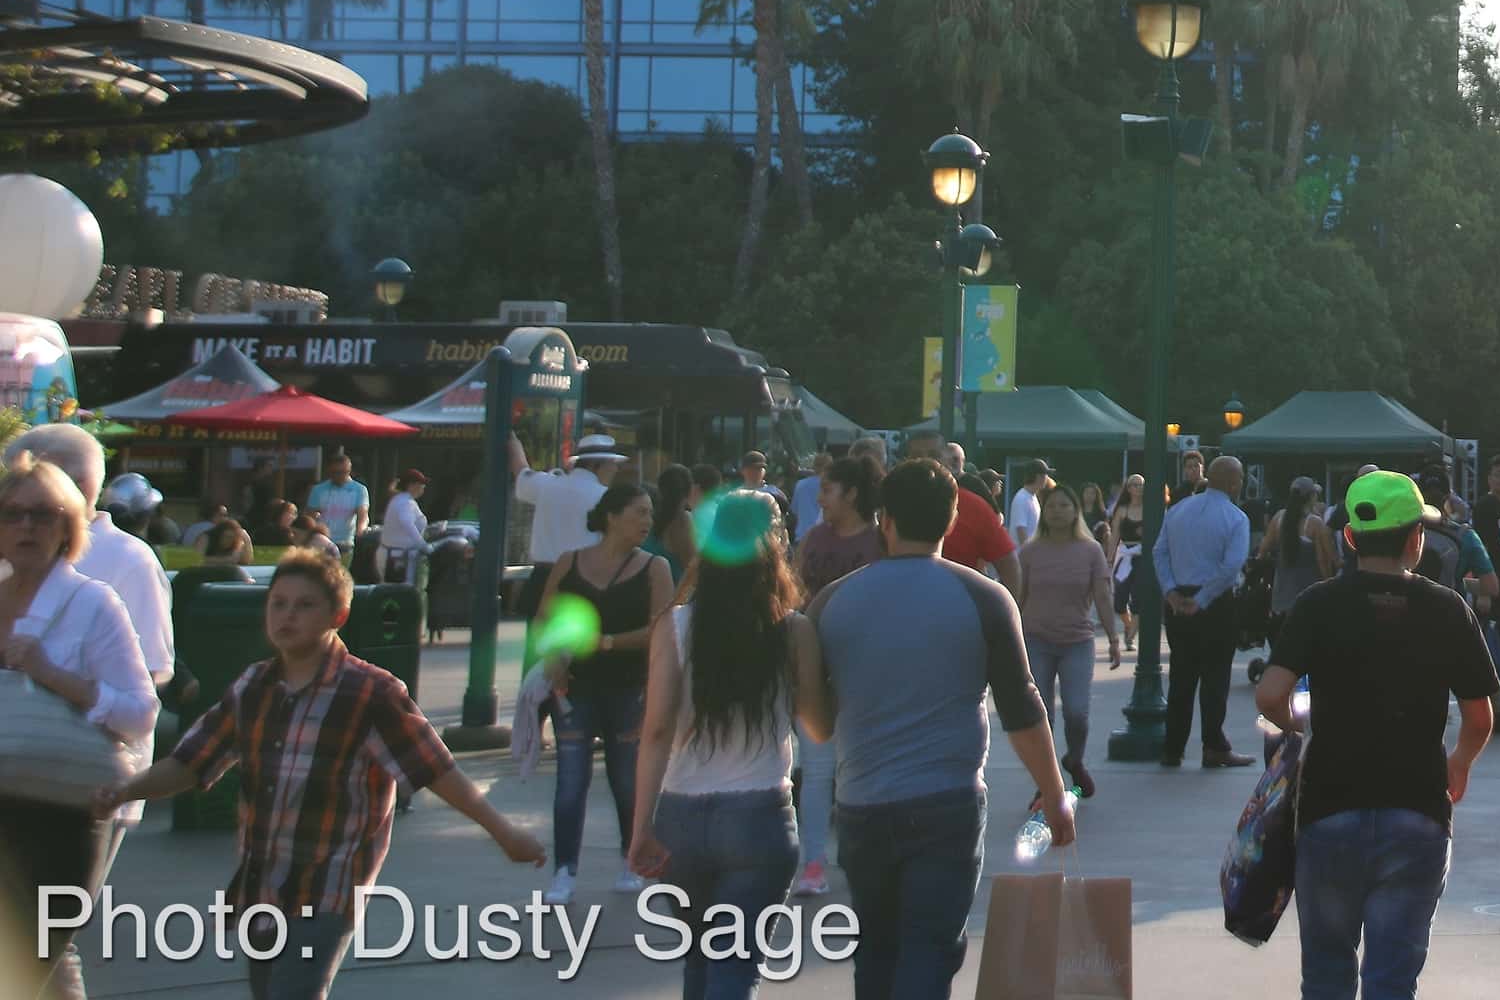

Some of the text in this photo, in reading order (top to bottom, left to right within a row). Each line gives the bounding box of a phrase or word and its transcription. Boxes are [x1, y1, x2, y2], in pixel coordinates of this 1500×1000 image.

[264, 345, 283, 359] IT
[284, 345, 298, 359] A
[304, 337, 377, 364] HABIT
